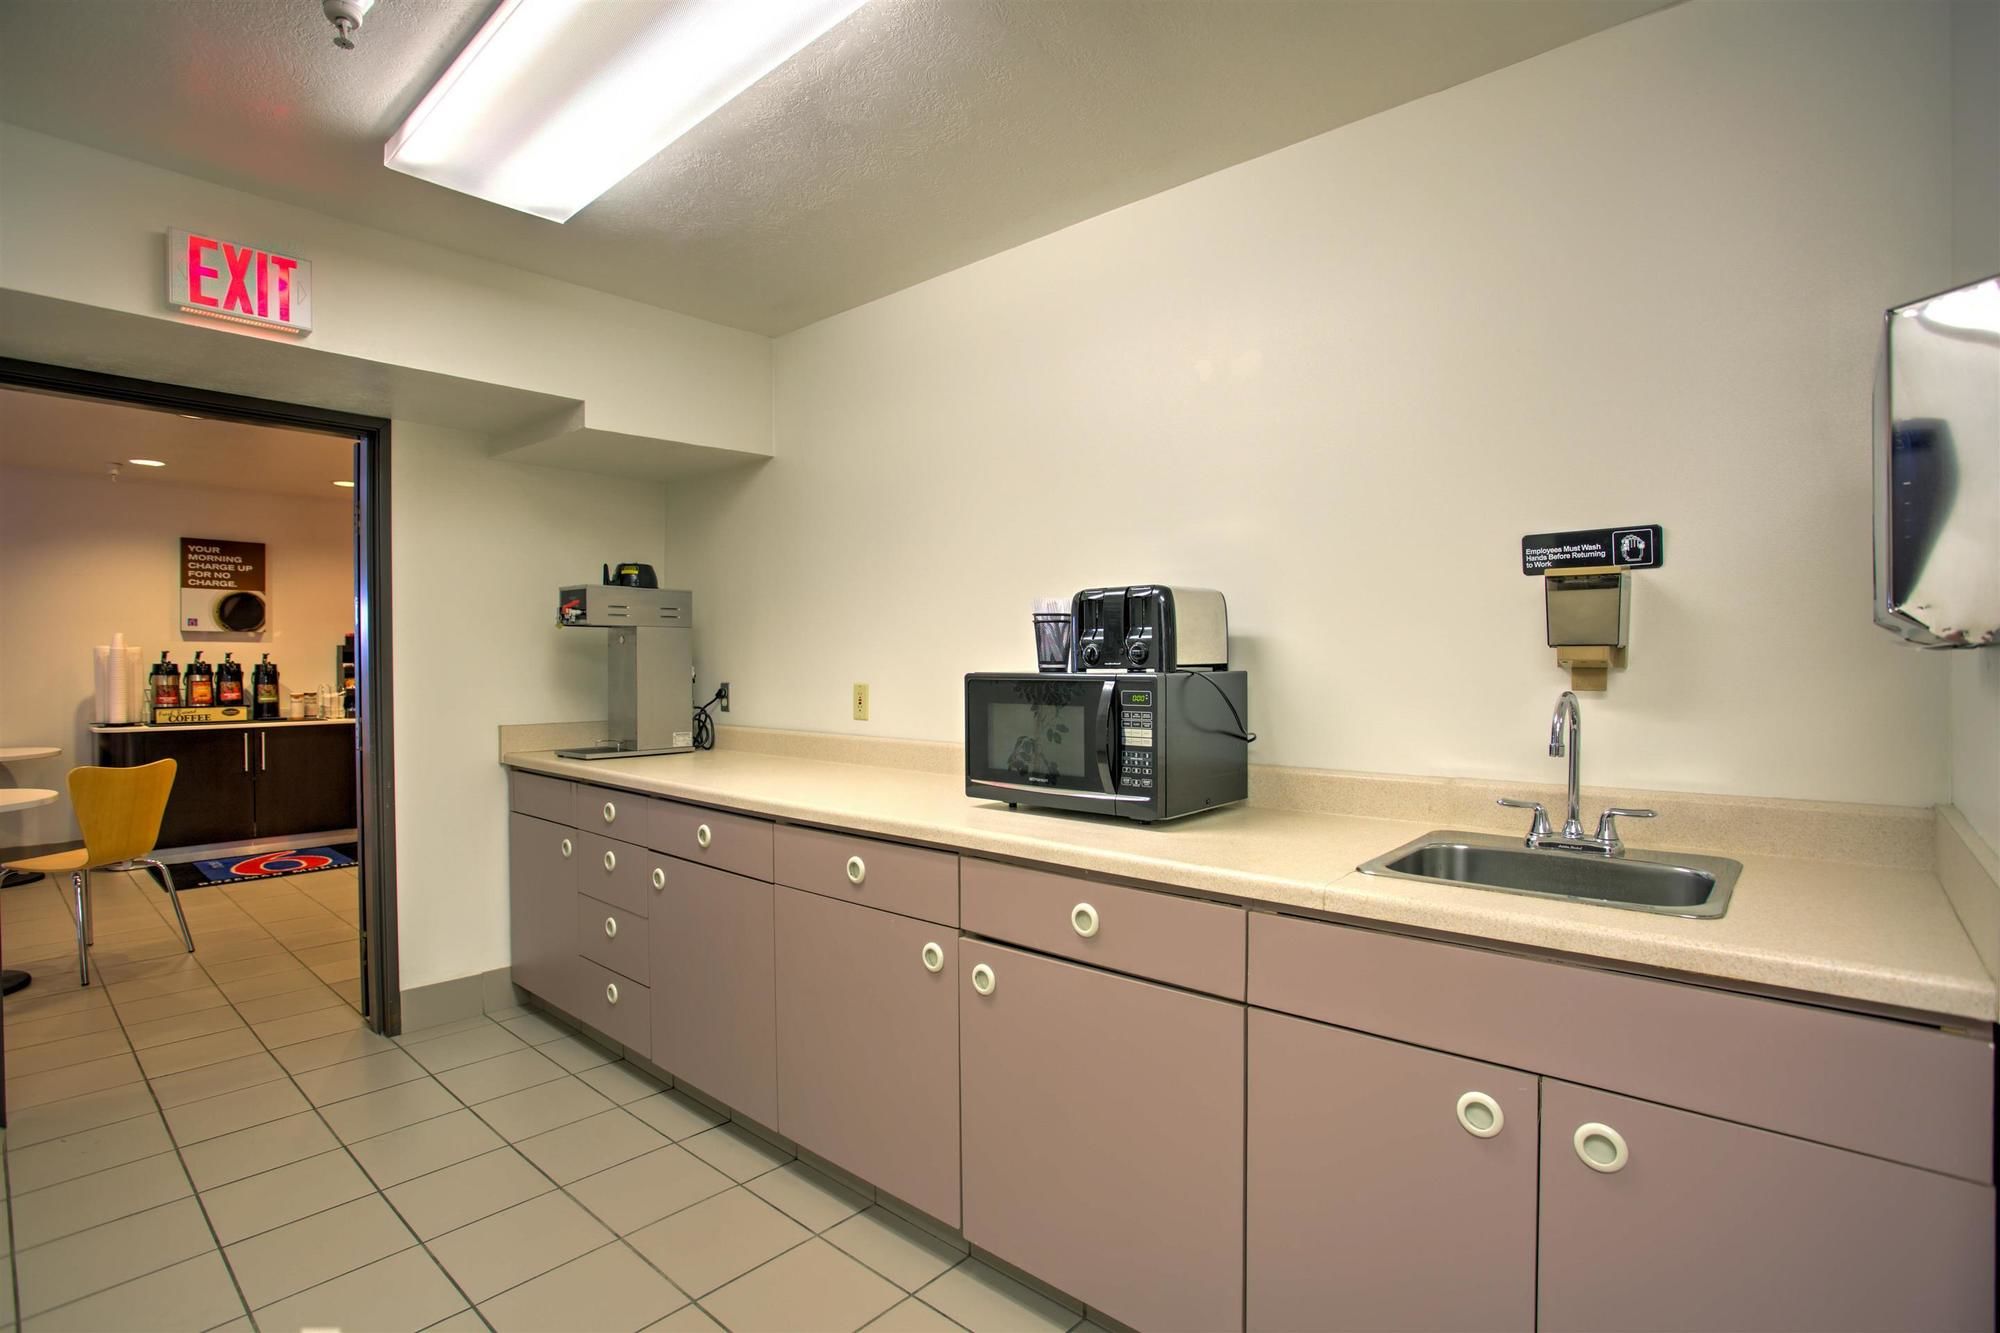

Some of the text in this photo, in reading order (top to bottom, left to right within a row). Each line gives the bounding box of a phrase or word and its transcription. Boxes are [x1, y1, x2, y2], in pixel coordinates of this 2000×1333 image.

[188, 234, 298, 322] EXIT
[187, 545, 220, 554] YOUR
[1526, 547, 1562, 555] Employees
[187, 554, 243, 563] MORNING
[1571, 551, 1606, 559] Returning
[187, 562, 235, 571] CHARGE
[187, 570, 211, 578] FOR
[187, 578, 238, 588] CHARGE.
[168, 713, 212, 722] COFFEE
[198, 862, 359, 886] BOZEMAN MONTAN
